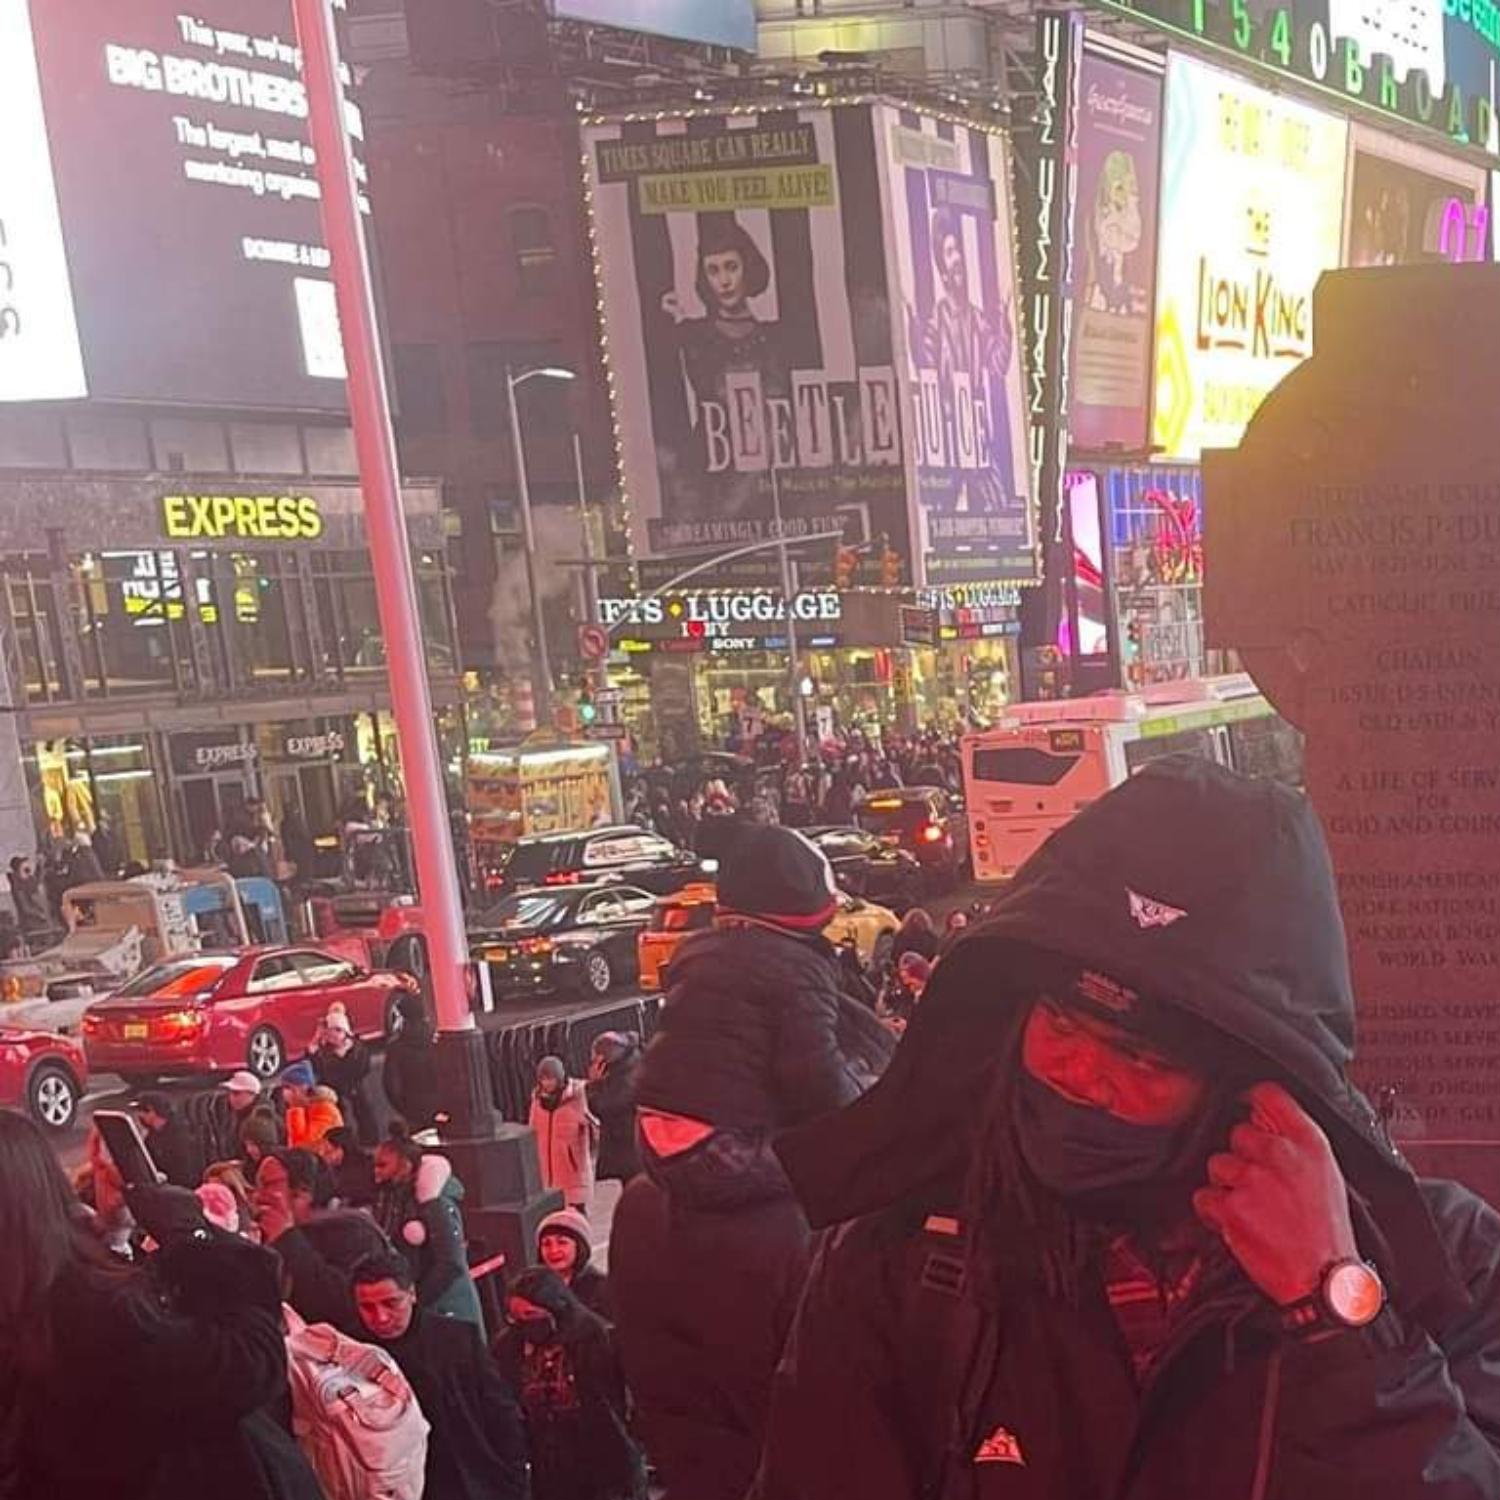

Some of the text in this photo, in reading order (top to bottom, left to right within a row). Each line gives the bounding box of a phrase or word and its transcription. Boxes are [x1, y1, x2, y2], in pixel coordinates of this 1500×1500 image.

[106, 43, 162, 91] BIG
[162, 55, 309, 118] BROTHERS
[704, 372, 899, 472] BEETLE
[164, 496, 322, 538] EXPRESS
[597, 594, 841, 623] IFTS LUGGAGE
